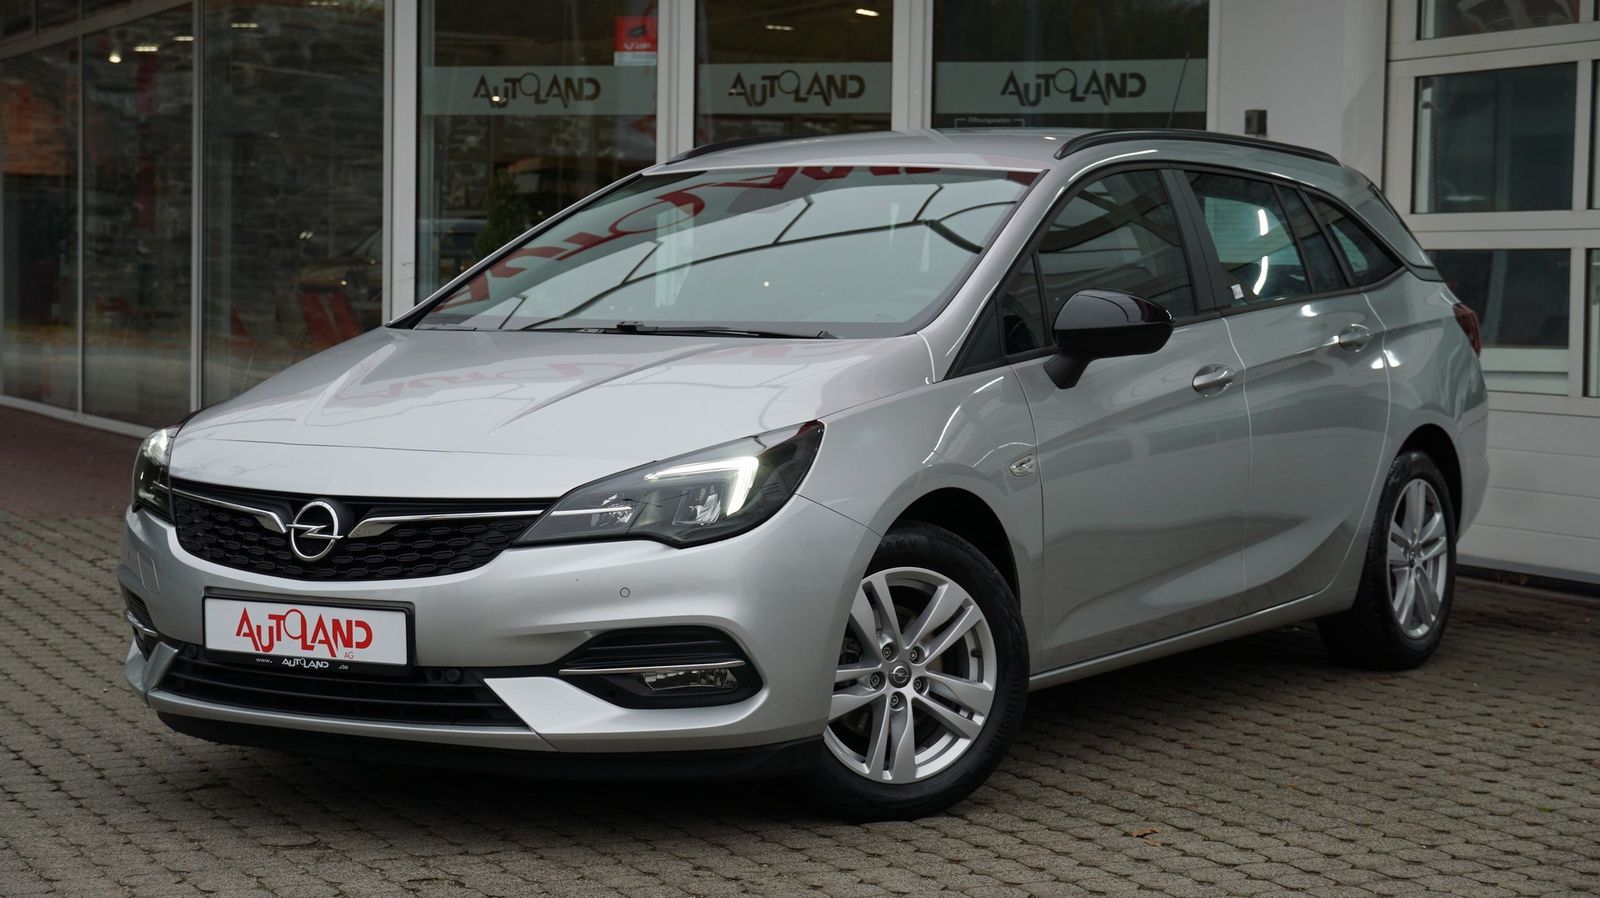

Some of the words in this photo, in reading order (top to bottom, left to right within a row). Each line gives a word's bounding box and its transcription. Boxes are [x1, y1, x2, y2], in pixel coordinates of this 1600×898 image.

[473, 72, 602, 109] AUTOLAND
[728, 69, 866, 107] AUTOLAND
[1000, 67, 1147, 107] AUTOLAND
[235, 607, 373, 657] AUTOLAND
[282, 658, 329, 669] AUTOLAND
[343, 651, 354, 660] AG
